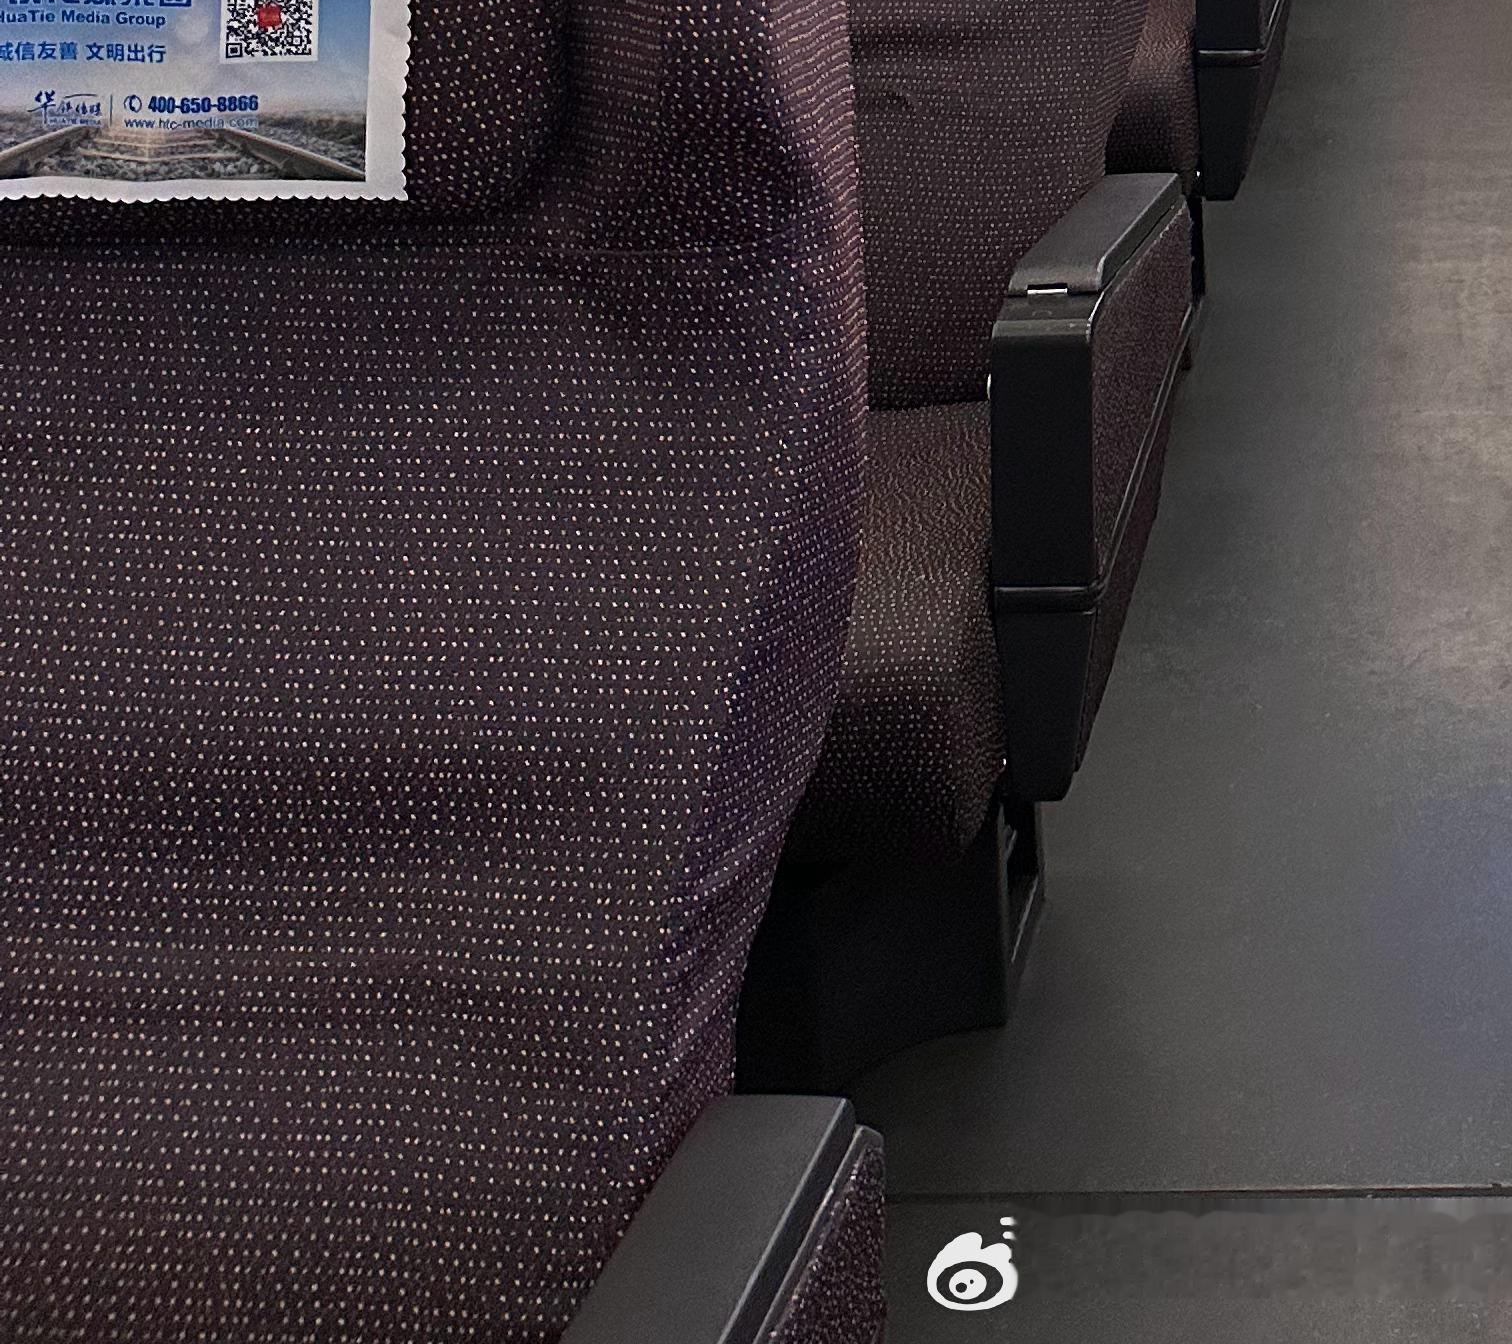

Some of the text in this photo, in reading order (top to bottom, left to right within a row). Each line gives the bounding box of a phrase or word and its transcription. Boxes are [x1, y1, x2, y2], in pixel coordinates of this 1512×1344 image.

[61, 9, 110, 25] Media
[116, 11, 167, 28] Group
[86, 42, 167, 63] 文明出行
[147, 95, 259, 113] 400-650-8866
